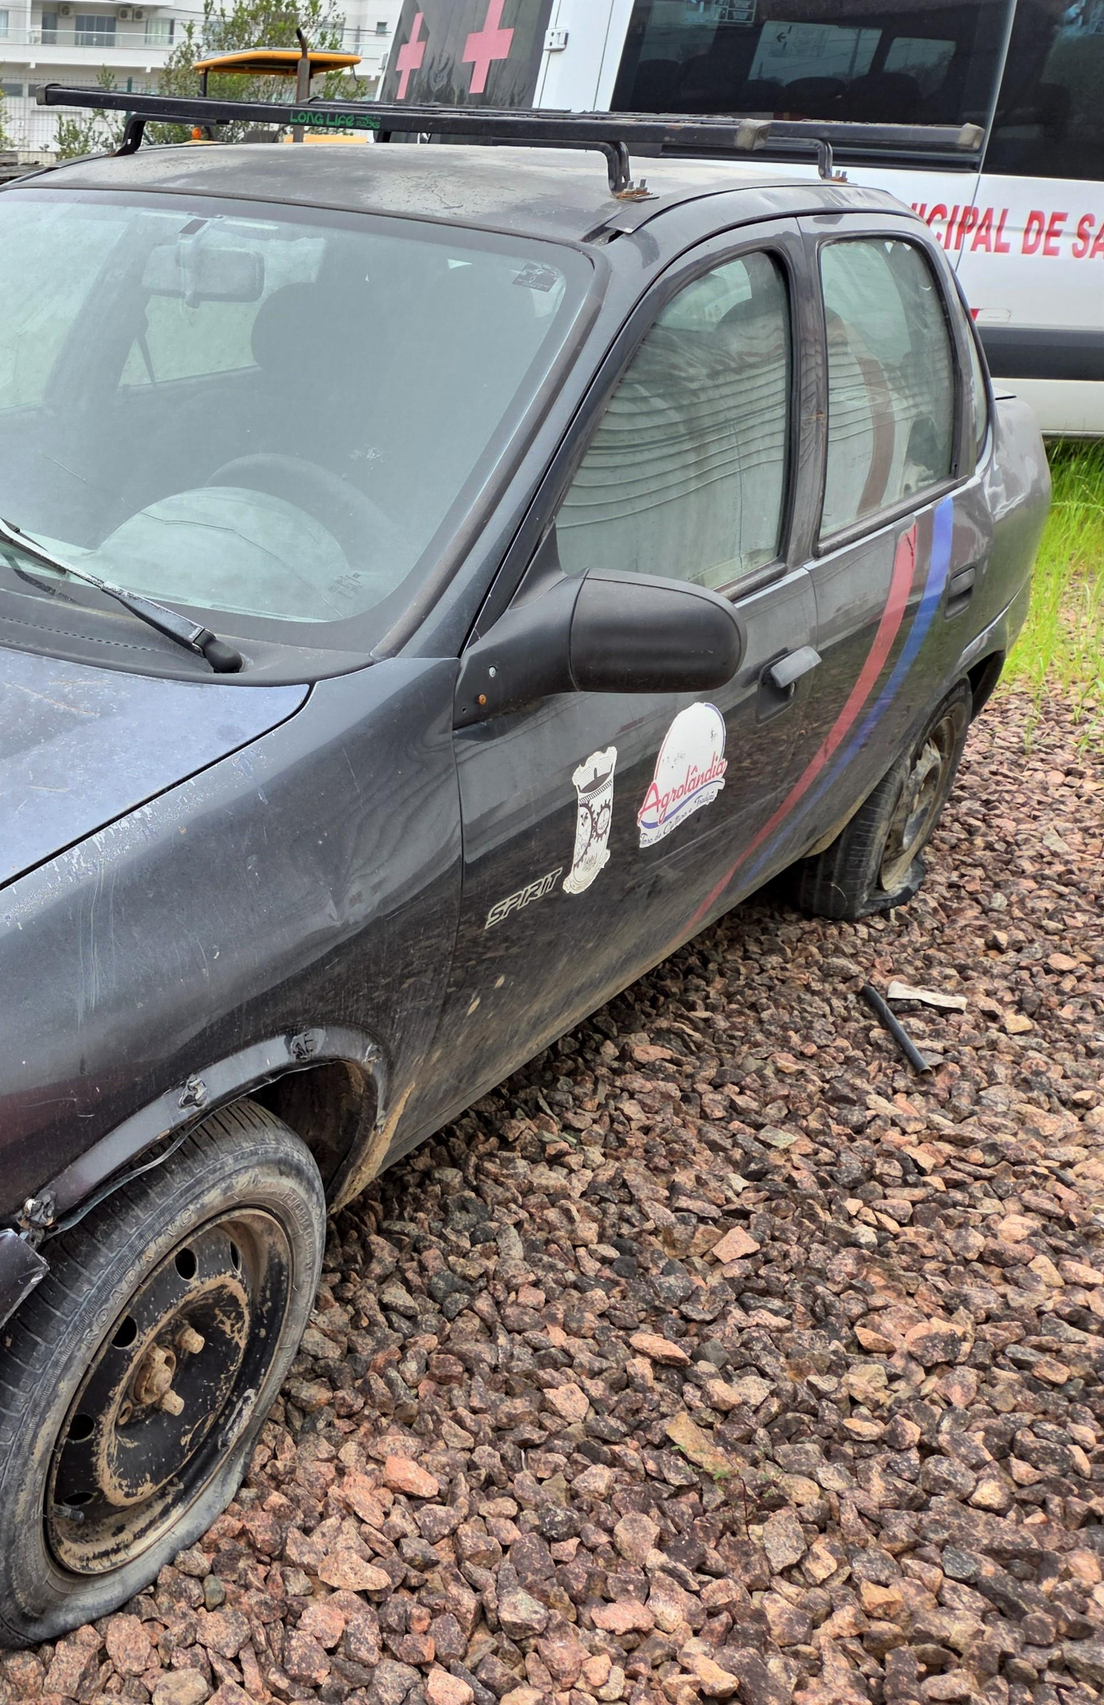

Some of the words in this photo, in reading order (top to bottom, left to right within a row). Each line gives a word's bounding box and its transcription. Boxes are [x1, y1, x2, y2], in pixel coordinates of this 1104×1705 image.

[290, 111, 323, 124] LONG
[1021, 210, 1069, 256] DE
[637, 751, 727, 824] Agrolândia
[484, 867, 563, 930] SPIRIT
[82, 1207, 194, 1348] ROADKING
